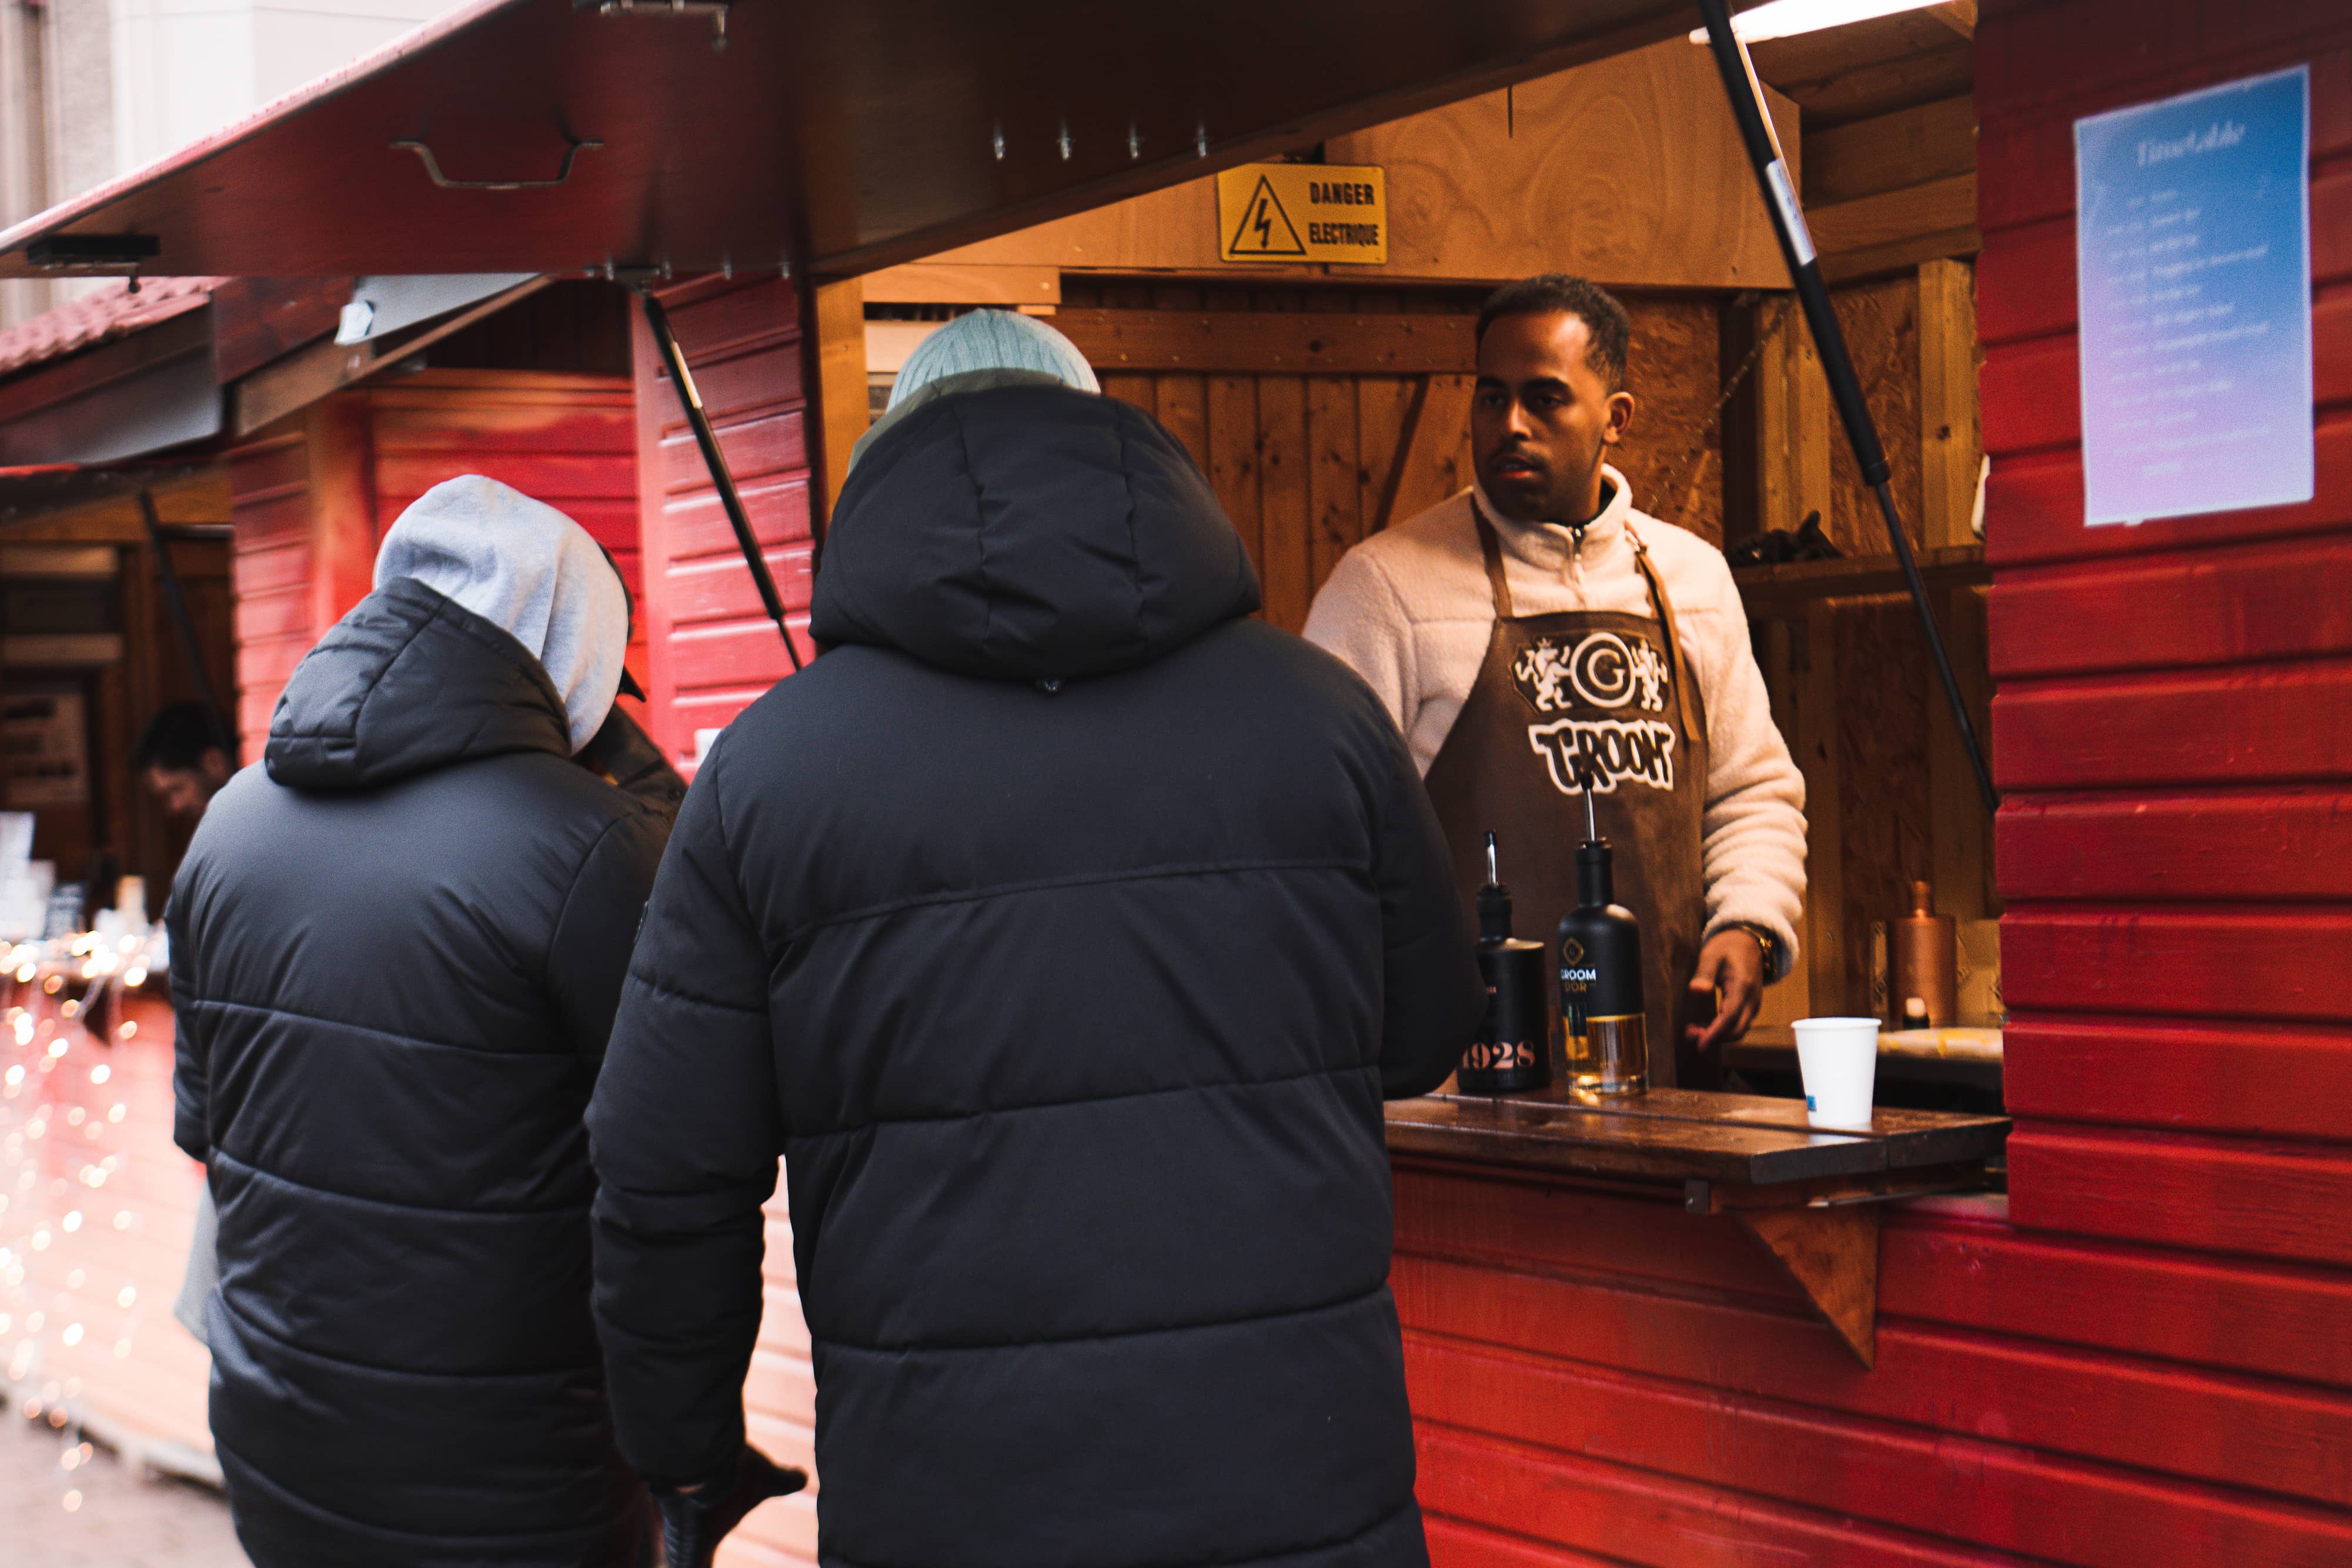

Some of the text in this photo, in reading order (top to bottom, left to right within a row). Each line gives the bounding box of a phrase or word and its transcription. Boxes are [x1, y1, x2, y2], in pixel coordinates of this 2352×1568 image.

[1309, 182, 1375, 205] DANGER
[1308, 222, 1379, 246] ELECTRIQUE
[1588, 648, 1625, 691] G
